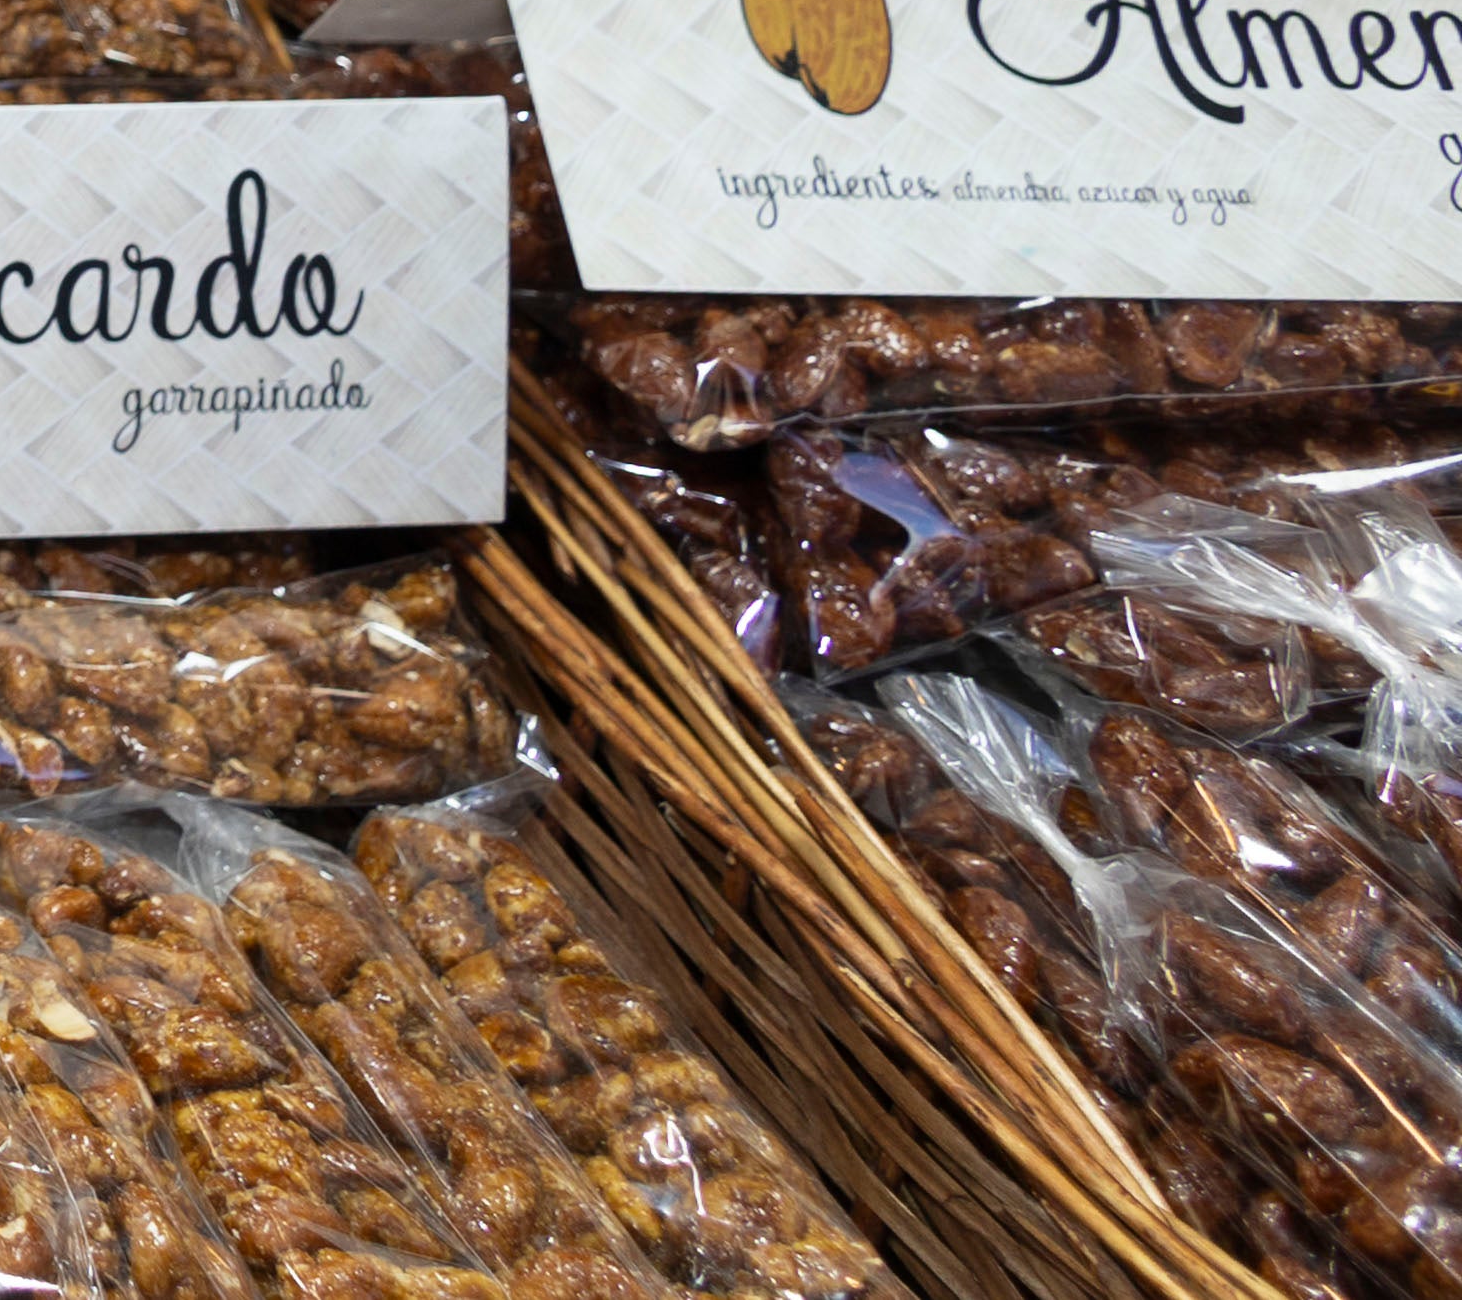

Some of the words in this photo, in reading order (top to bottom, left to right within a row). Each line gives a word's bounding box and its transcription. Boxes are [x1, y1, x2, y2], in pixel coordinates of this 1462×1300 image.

[1165, 188, 1189, 227] y
[1191, 188, 1258, 227] agua
[112, 358, 374, 454] garrapiñado
